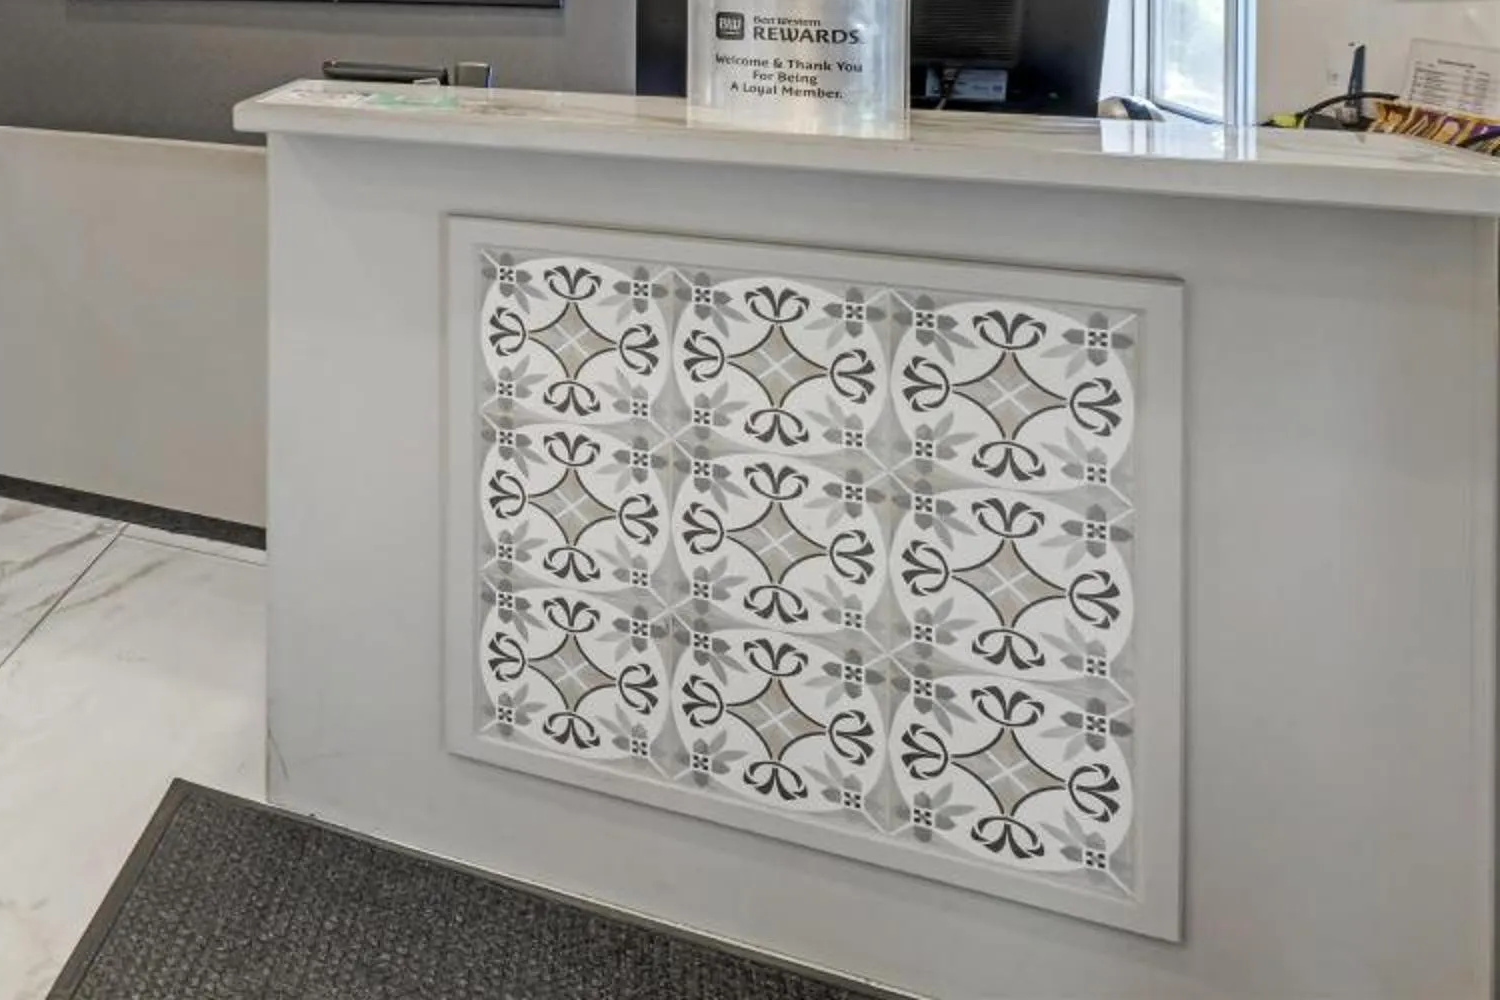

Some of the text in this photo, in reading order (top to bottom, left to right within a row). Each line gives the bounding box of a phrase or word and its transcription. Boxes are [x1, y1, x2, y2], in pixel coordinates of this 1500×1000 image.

[753, 15, 821, 27] Best Western
[753, 26, 860, 45] REWARDS
[715, 53, 863, 73] Welcome & Thank You
[753, 71, 818, 85] For Being
[730, 82, 843, 99] A Loyal Member.
